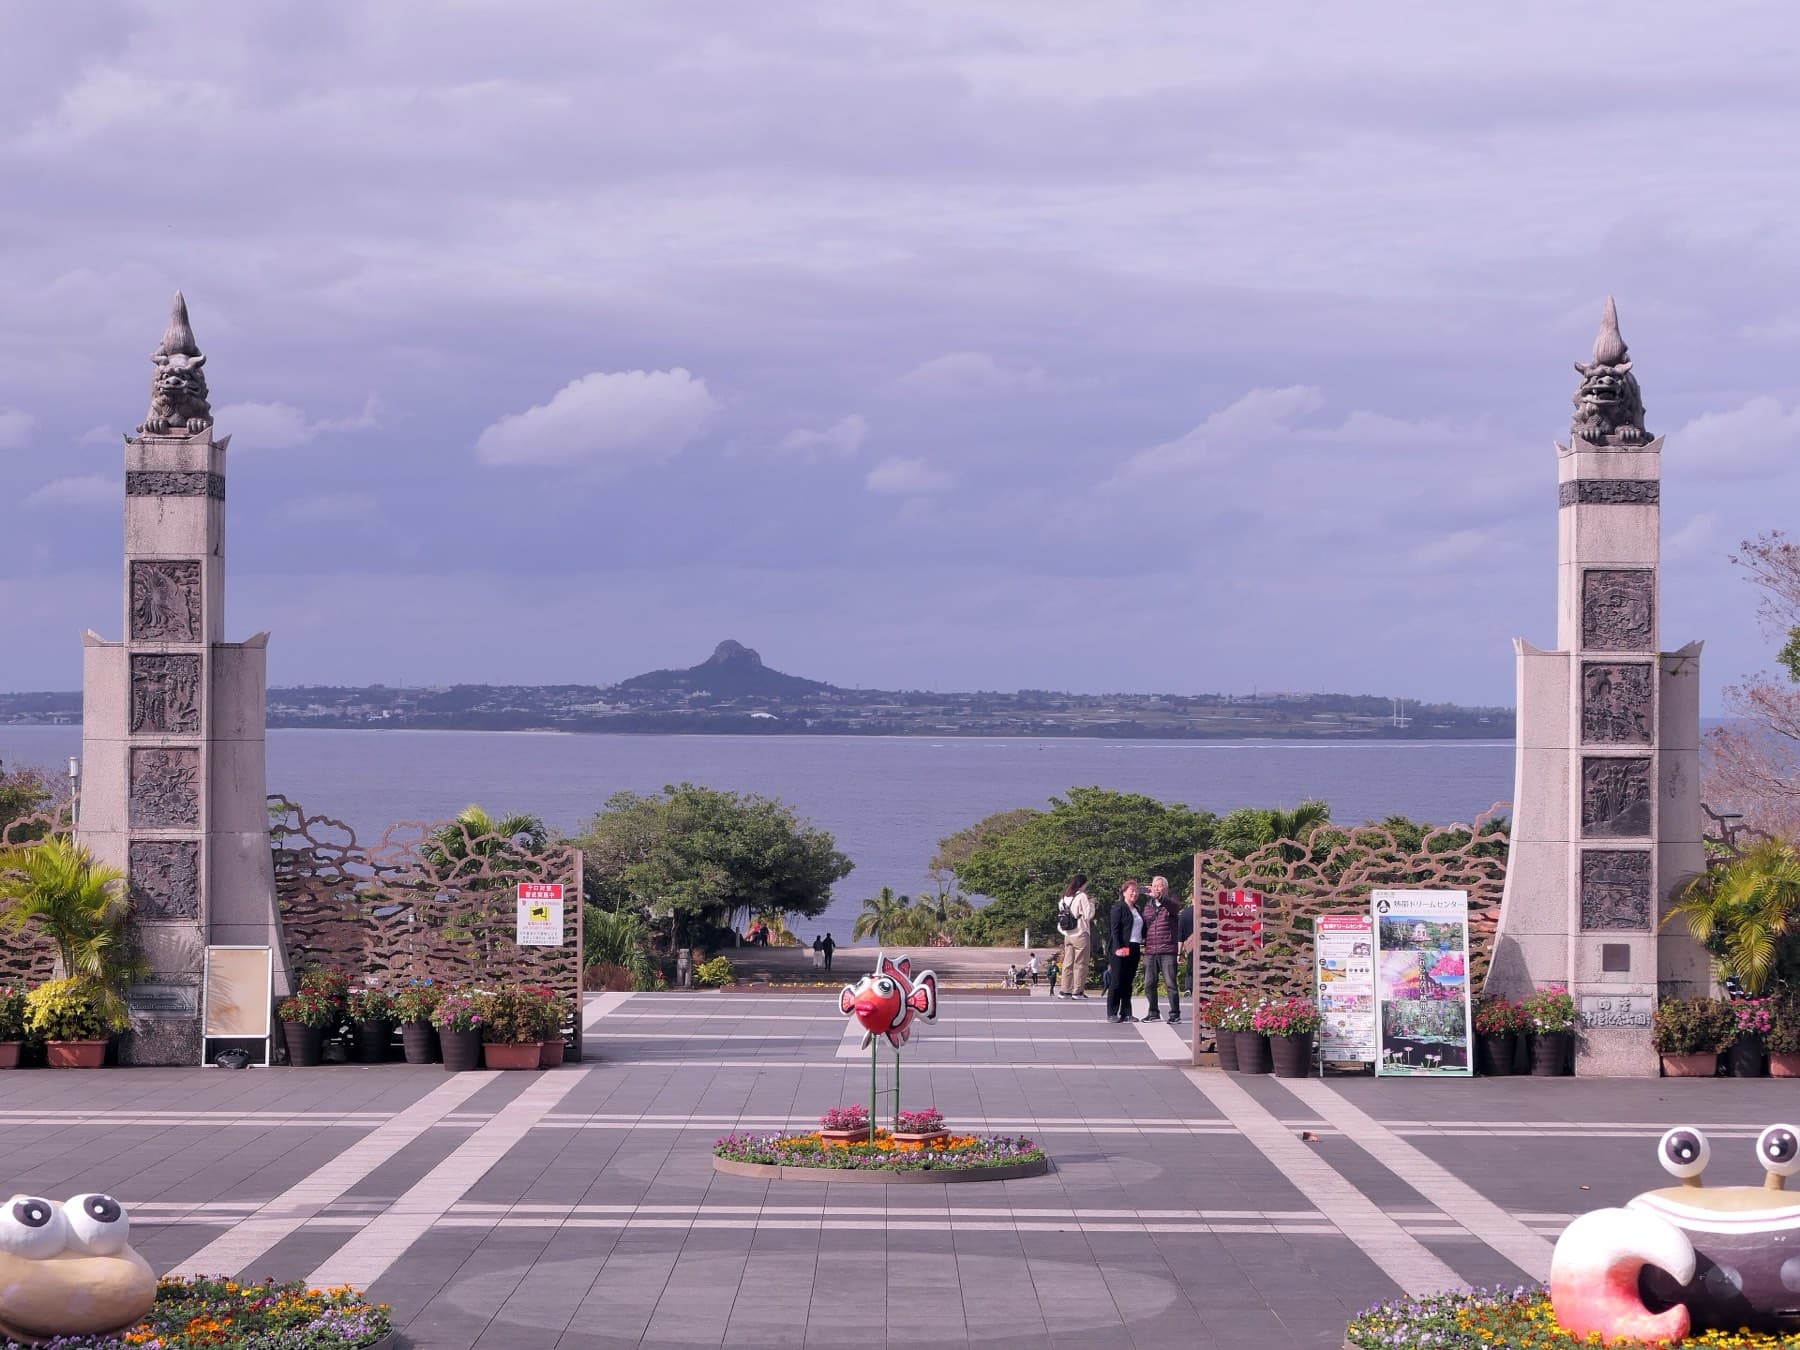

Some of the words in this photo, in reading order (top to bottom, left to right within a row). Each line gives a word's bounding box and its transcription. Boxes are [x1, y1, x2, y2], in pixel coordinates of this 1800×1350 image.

[1393, 900, 1464, 909] 熱帯ドリームセンター
